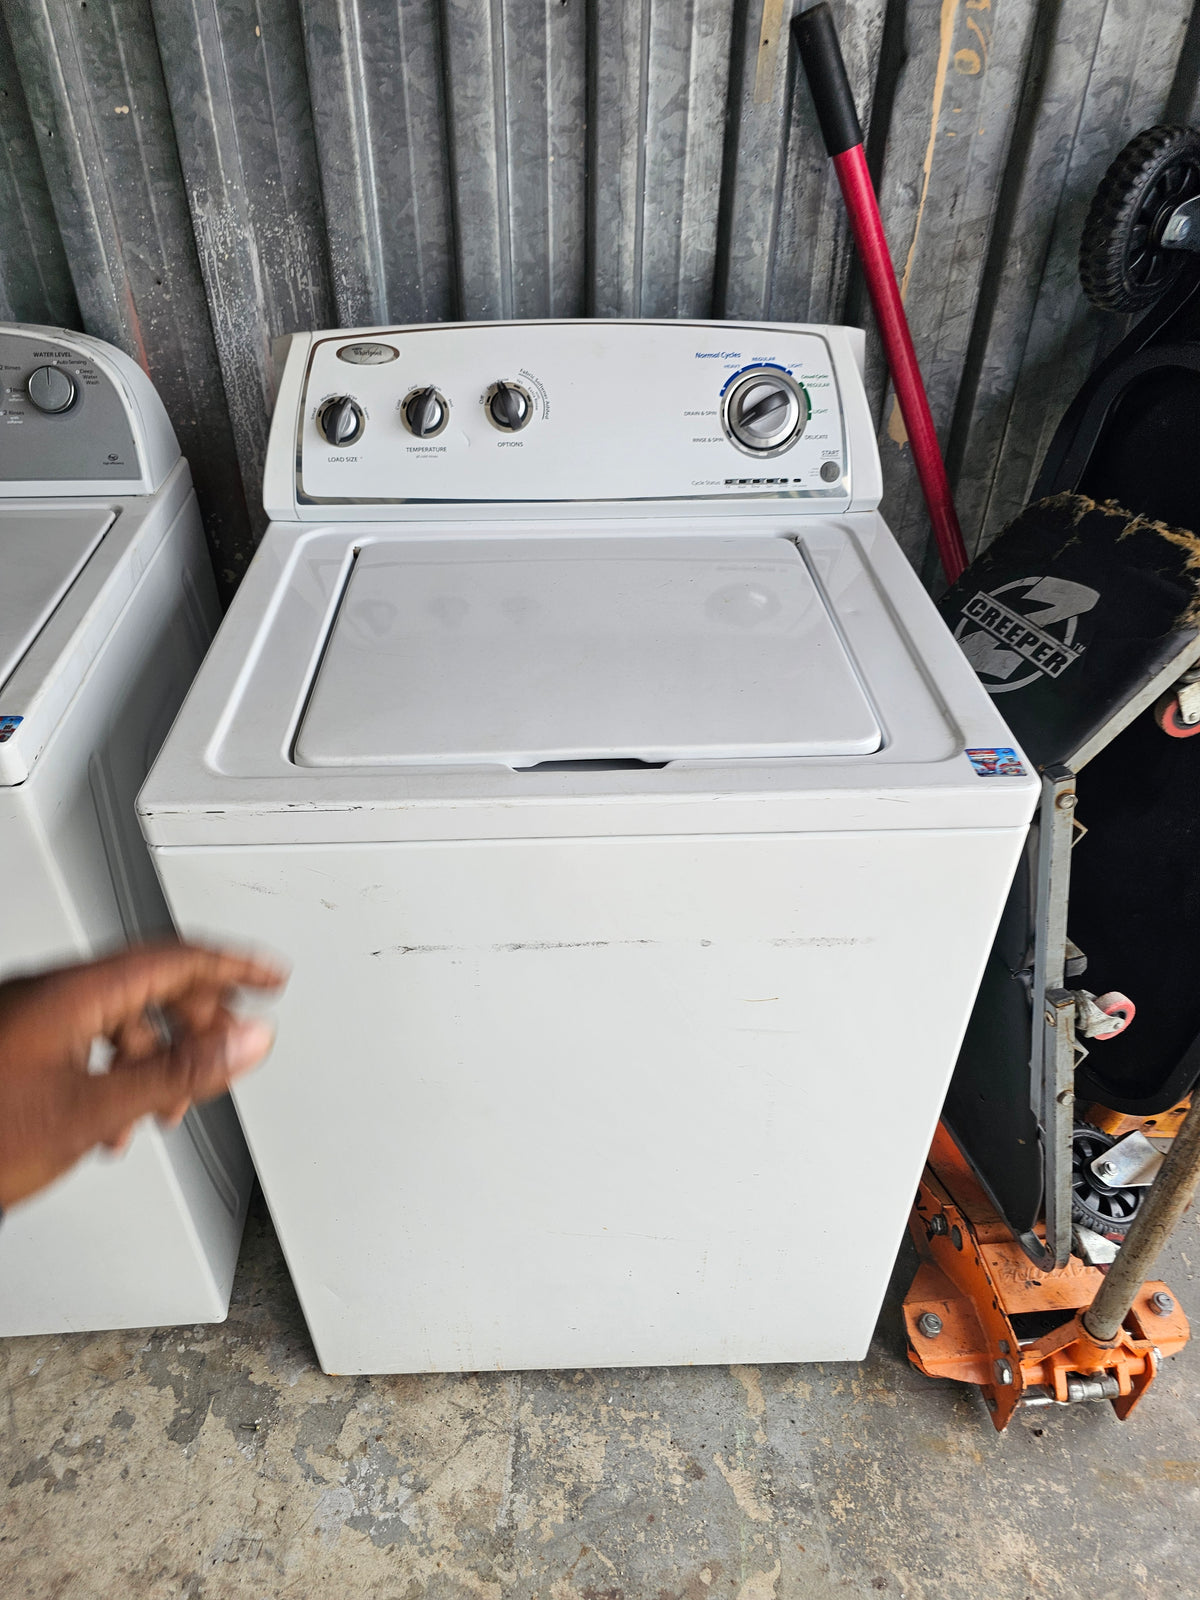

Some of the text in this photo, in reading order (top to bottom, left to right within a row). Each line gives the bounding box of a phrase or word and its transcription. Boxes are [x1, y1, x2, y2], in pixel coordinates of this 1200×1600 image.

[519, 368, 535, 379] Fabric
[535, 377, 548, 400] Softener
[966, 597, 1069, 675] CREEPER
